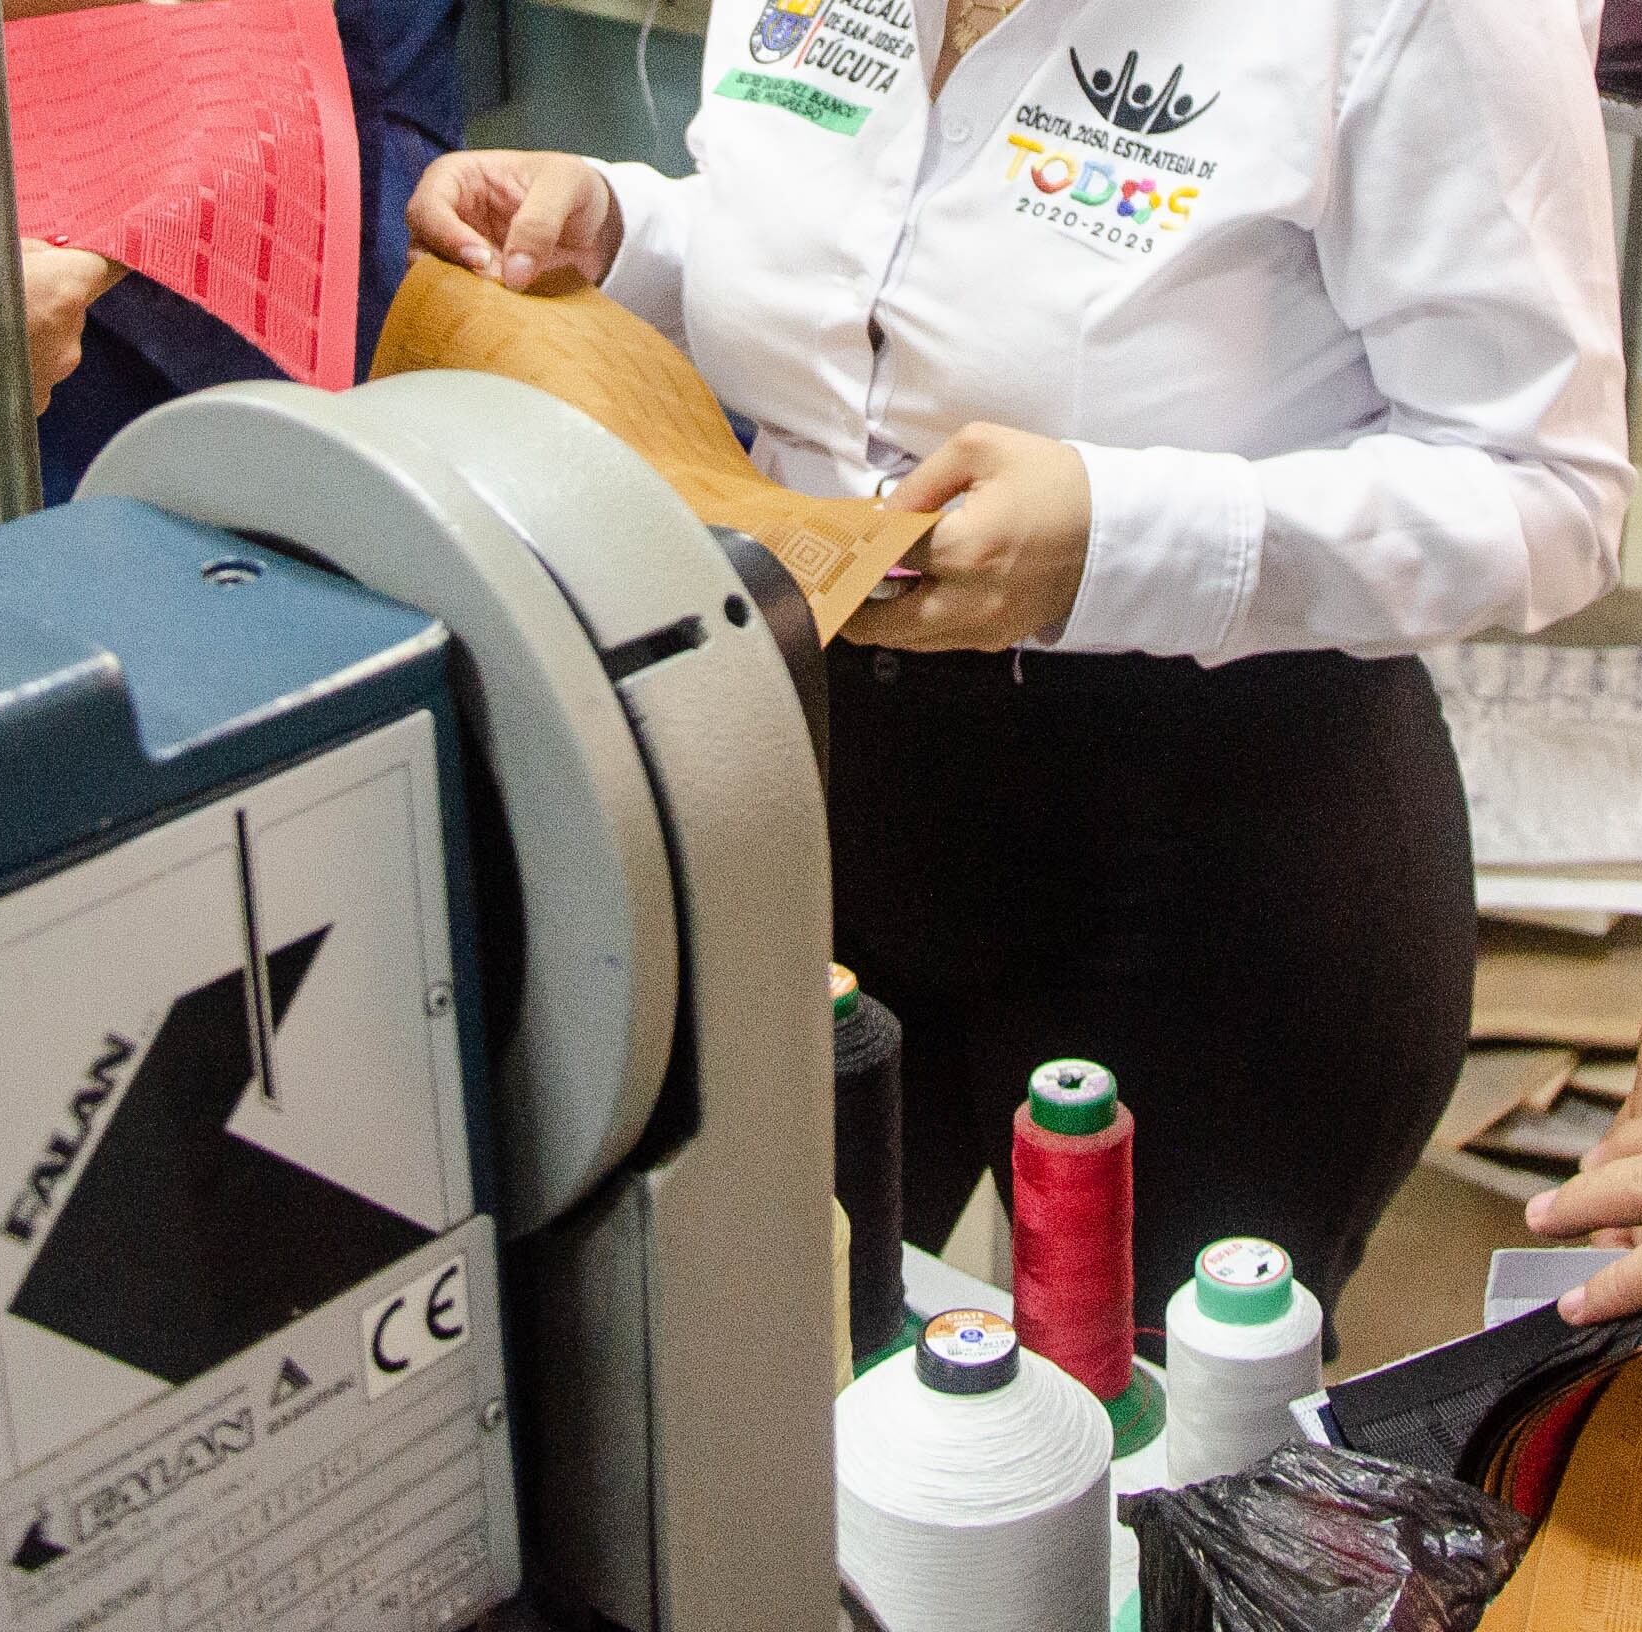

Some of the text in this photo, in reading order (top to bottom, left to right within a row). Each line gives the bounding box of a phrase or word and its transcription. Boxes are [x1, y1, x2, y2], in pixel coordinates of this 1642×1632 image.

[803, 35, 900, 94] CÚCUTA
[839, 18, 870, 41] SAN
[868, 31, 905, 57] JOSÉ
[1015, 104, 1072, 138] CÚCUTA
[1112, 136, 1196, 176] ESTRATEGIA
[1196, 161, 1218, 180] DE
[1006, 133, 1201, 231] TODOS
[1015, 196, 1155, 254] 2020-2023
[1, 1034, 135, 1245] FALAN
